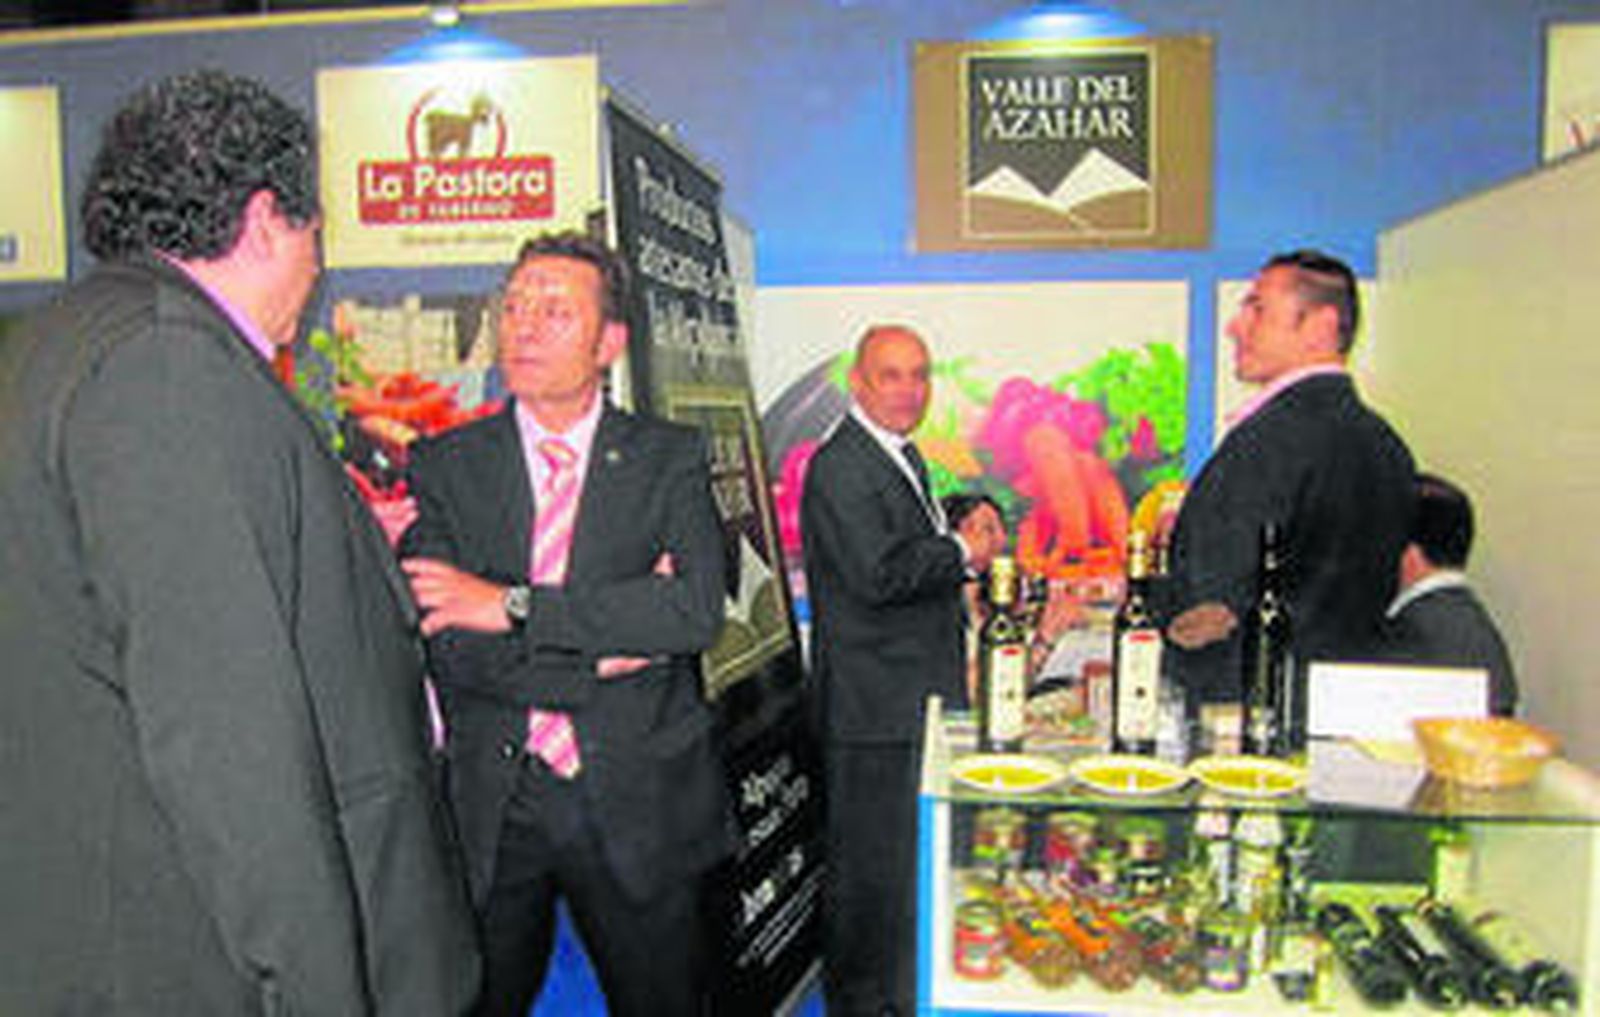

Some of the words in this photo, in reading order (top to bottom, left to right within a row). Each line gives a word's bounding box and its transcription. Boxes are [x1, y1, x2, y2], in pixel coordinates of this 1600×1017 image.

[981, 76, 1073, 105] VALLE
[1077, 74, 1138, 102] DEL
[984, 106, 1134, 140] AZAHAR
[364, 167, 403, 200] La
[413, 164, 547, 198] Pastora
